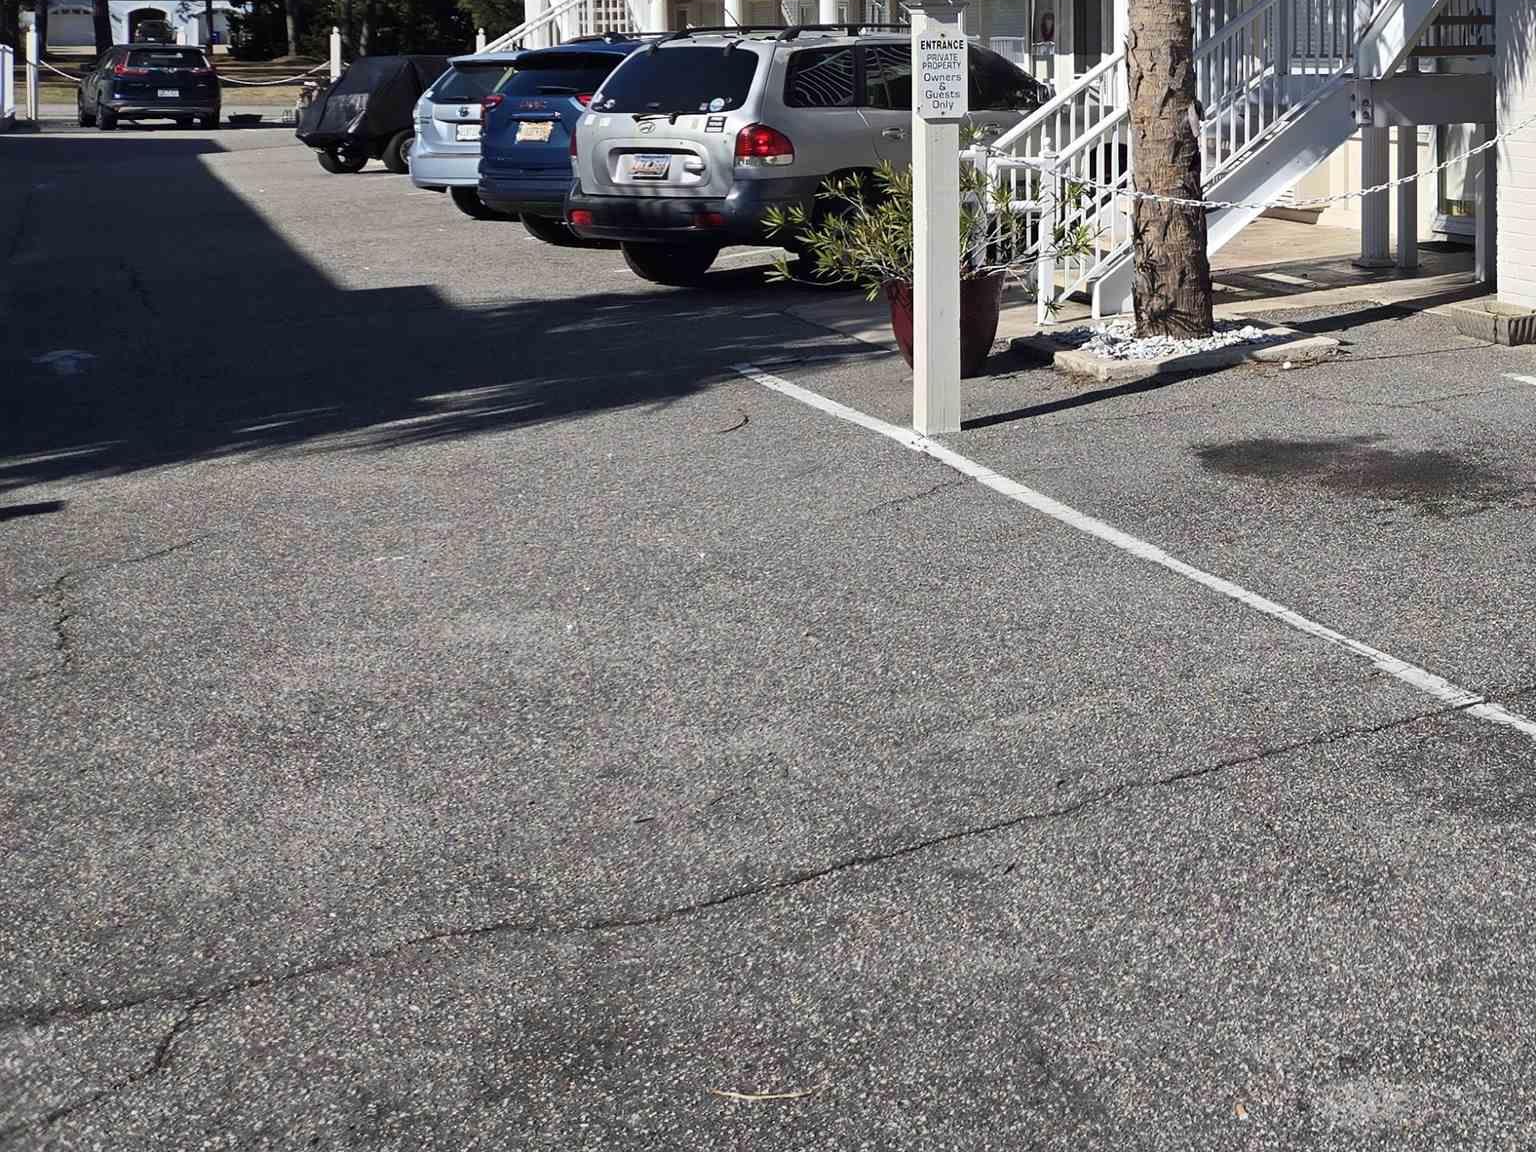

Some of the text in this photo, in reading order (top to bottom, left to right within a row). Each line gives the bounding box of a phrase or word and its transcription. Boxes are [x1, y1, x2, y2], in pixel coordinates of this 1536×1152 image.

[920, 39, 964, 50] ENTRANCE
[926, 53, 959, 62] PRIVATE
[922, 61, 961, 70] PROPERTY
[923, 72, 962, 82] Owners
[938, 81, 946, 91] &
[925, 89, 961, 99] Guests
[932, 99, 954, 111] Only
